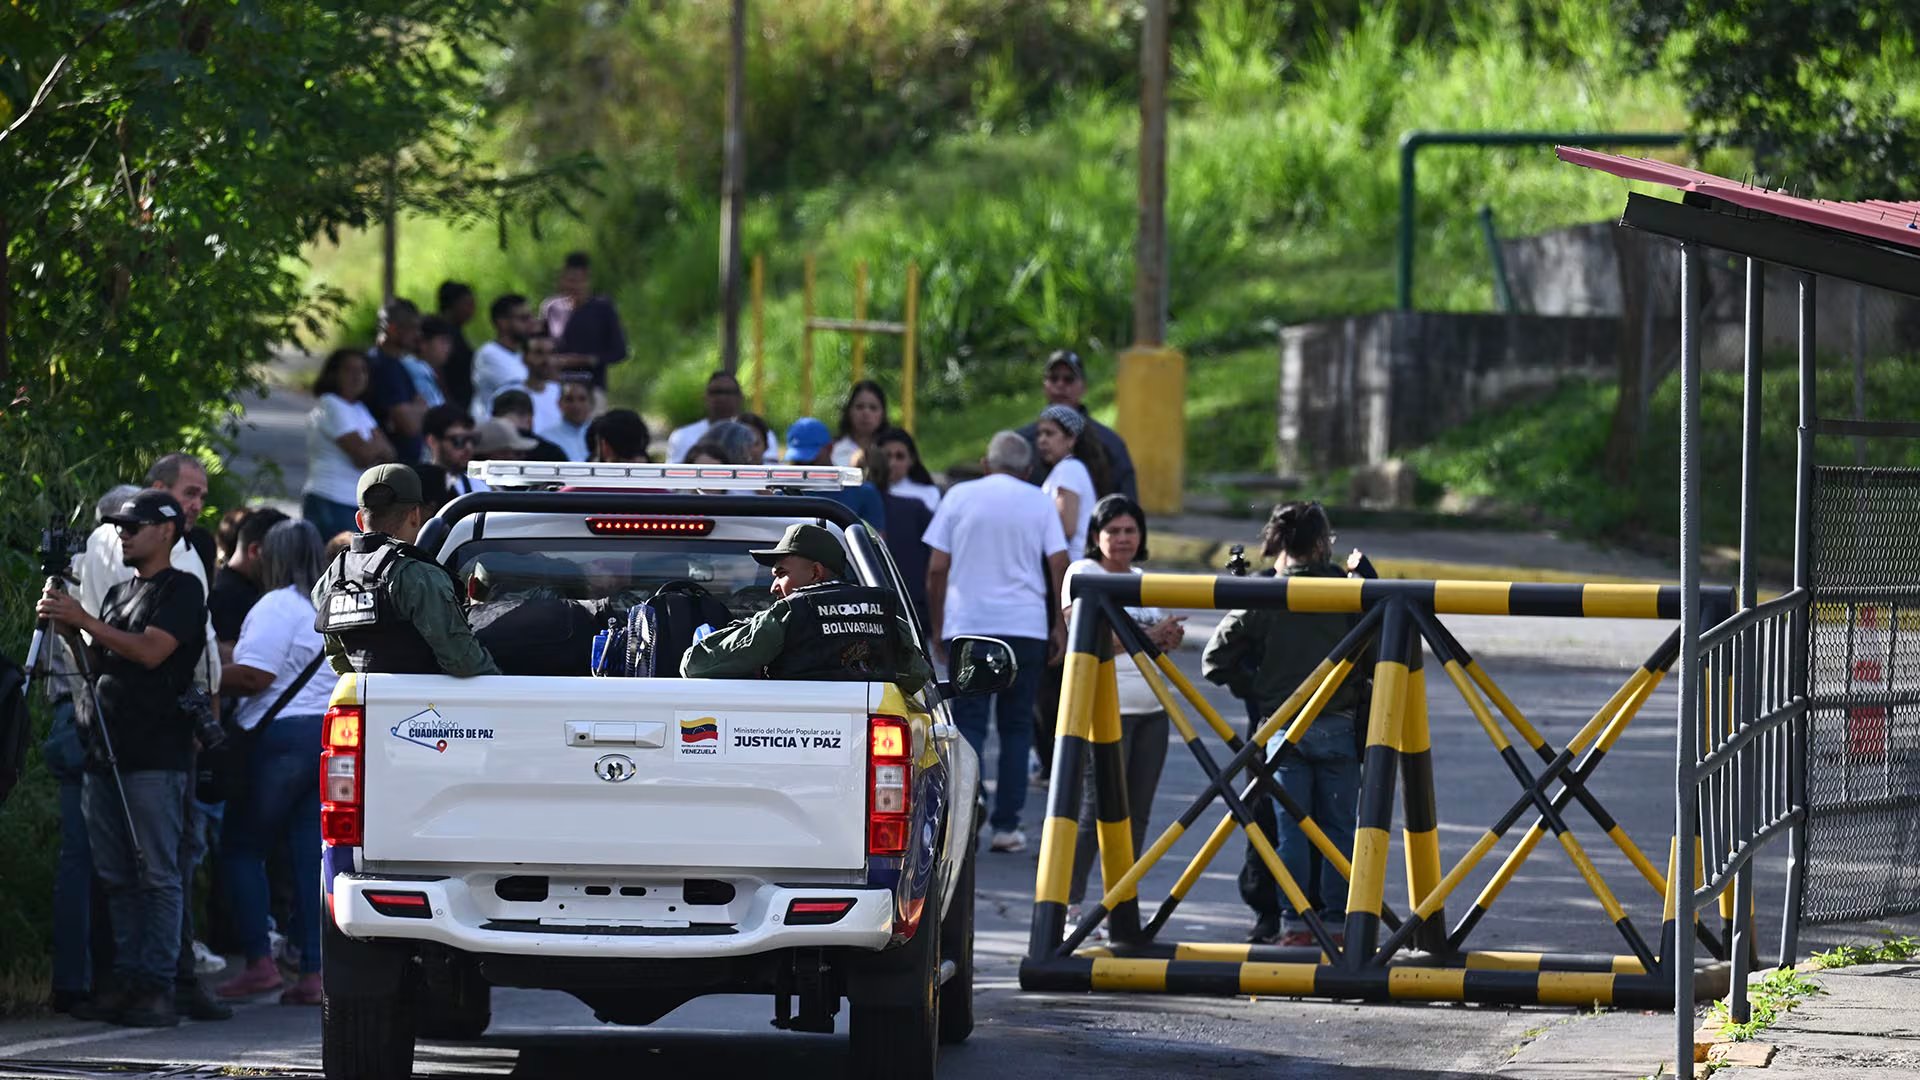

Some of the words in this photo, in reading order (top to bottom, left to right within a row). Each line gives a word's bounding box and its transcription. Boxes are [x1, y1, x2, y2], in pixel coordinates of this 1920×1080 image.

[330, 592, 373, 613] GNB
[822, 622, 884, 635] BOLIVARIANA
[408, 720, 430, 729] Gran
[409, 728, 464, 738] CUADRANTES
[466, 729, 476, 738] DE
[478, 729, 494, 738] PAZ
[796, 728, 819, 736] Popular
[734, 736, 797, 748] JUSTICIA
[800, 737, 810, 748] Y
[813, 737, 841, 749] PAZ
